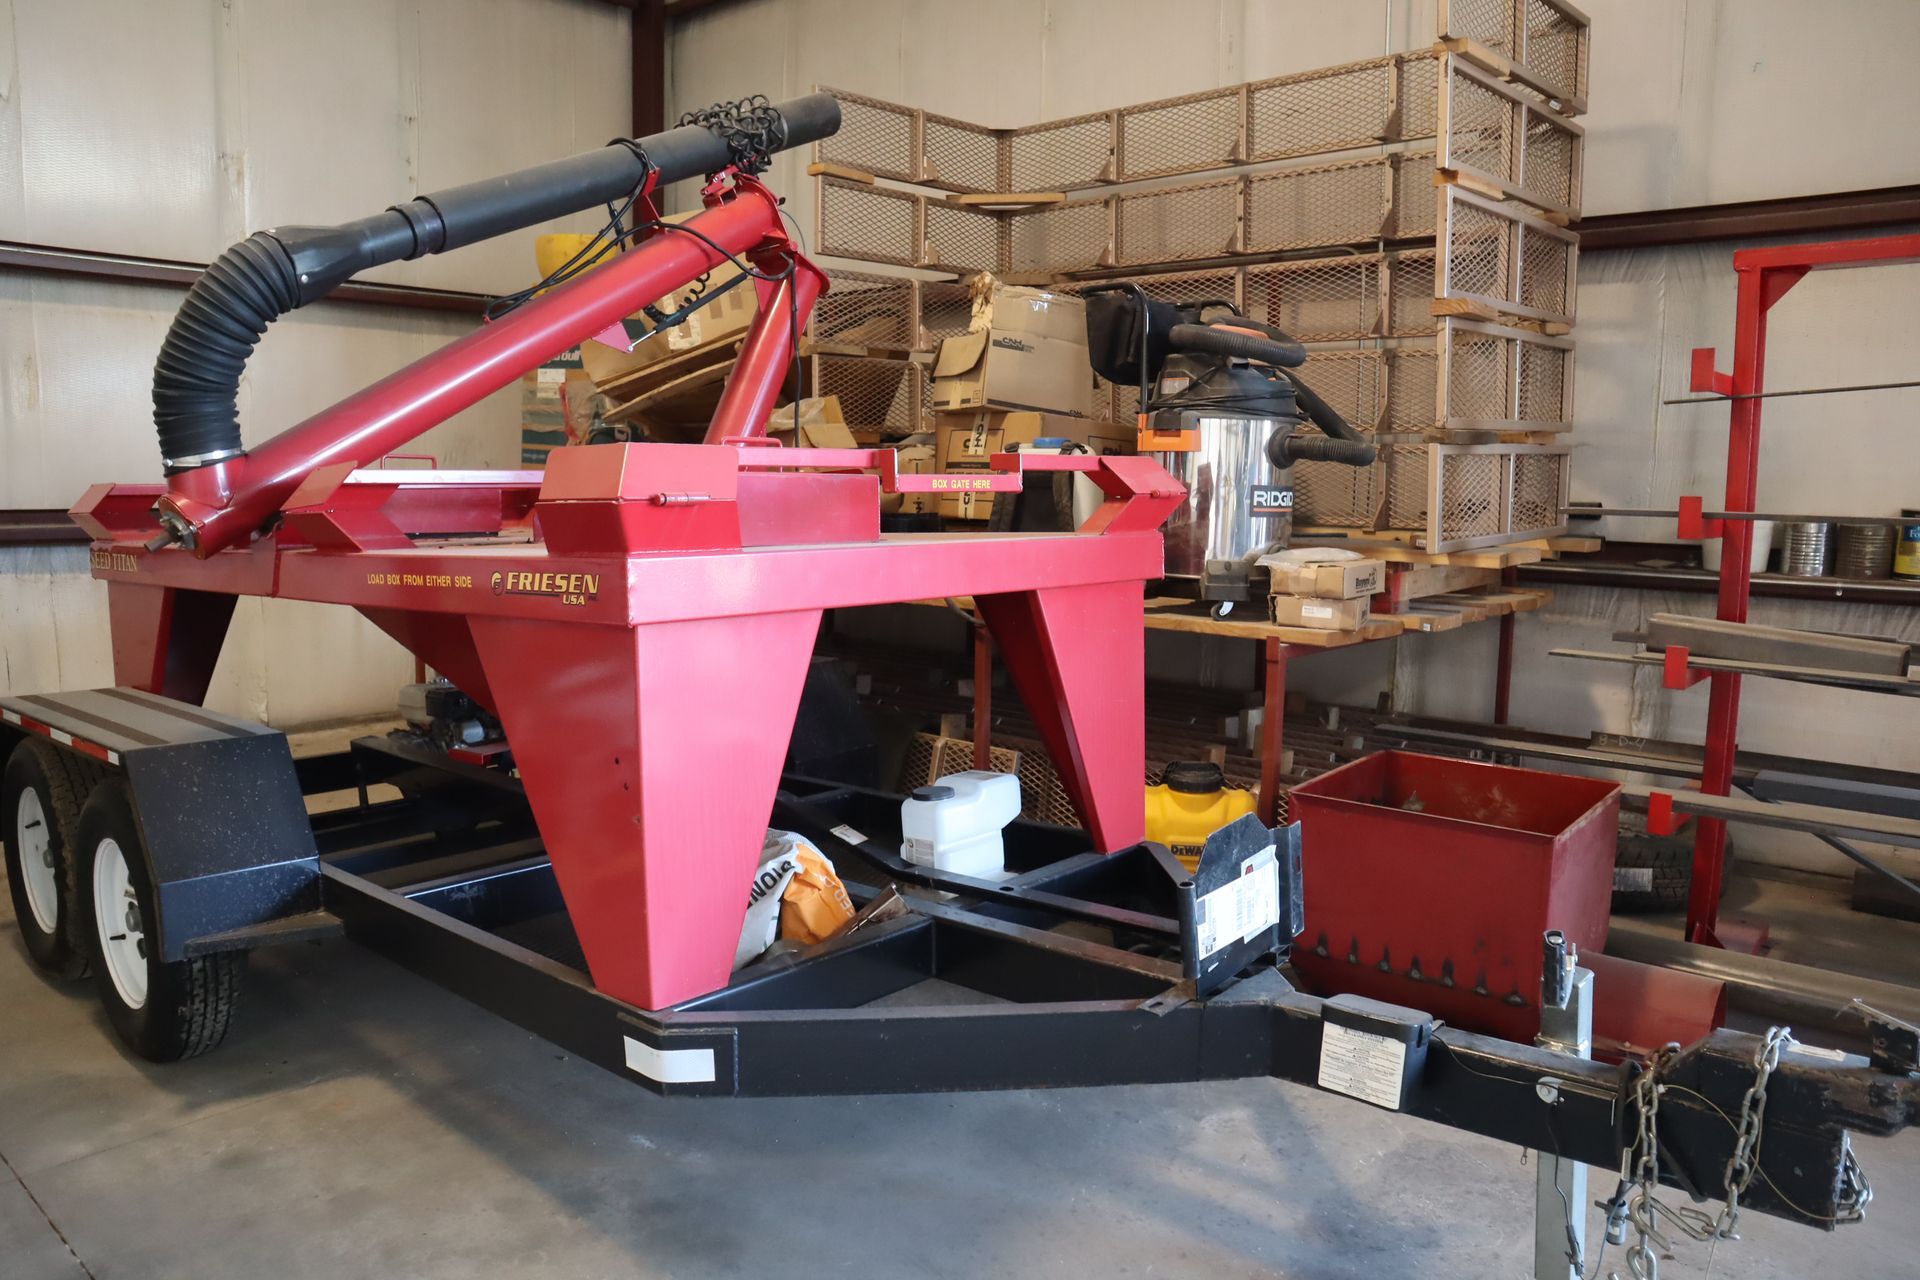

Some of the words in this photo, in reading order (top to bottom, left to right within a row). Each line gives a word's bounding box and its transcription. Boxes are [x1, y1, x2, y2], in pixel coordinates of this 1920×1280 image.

[932, 479, 948, 489] BOX
[951, 479, 970, 489] GATE
[972, 479, 991, 489] HERE
[1253, 490, 1294, 507] RIDGID
[91, 552, 111, 570] SEED
[112, 553, 137, 572] TITAN
[367, 573, 385, 585] LOAD
[387, 574, 400, 585] BOX
[403, 574, 424, 586] FROM
[426, 575, 452, 587] EITHER
[454, 575, 472, 588] SIDE
[506, 571, 600, 594] FRIESEN
[562, 593, 585, 605] USA
